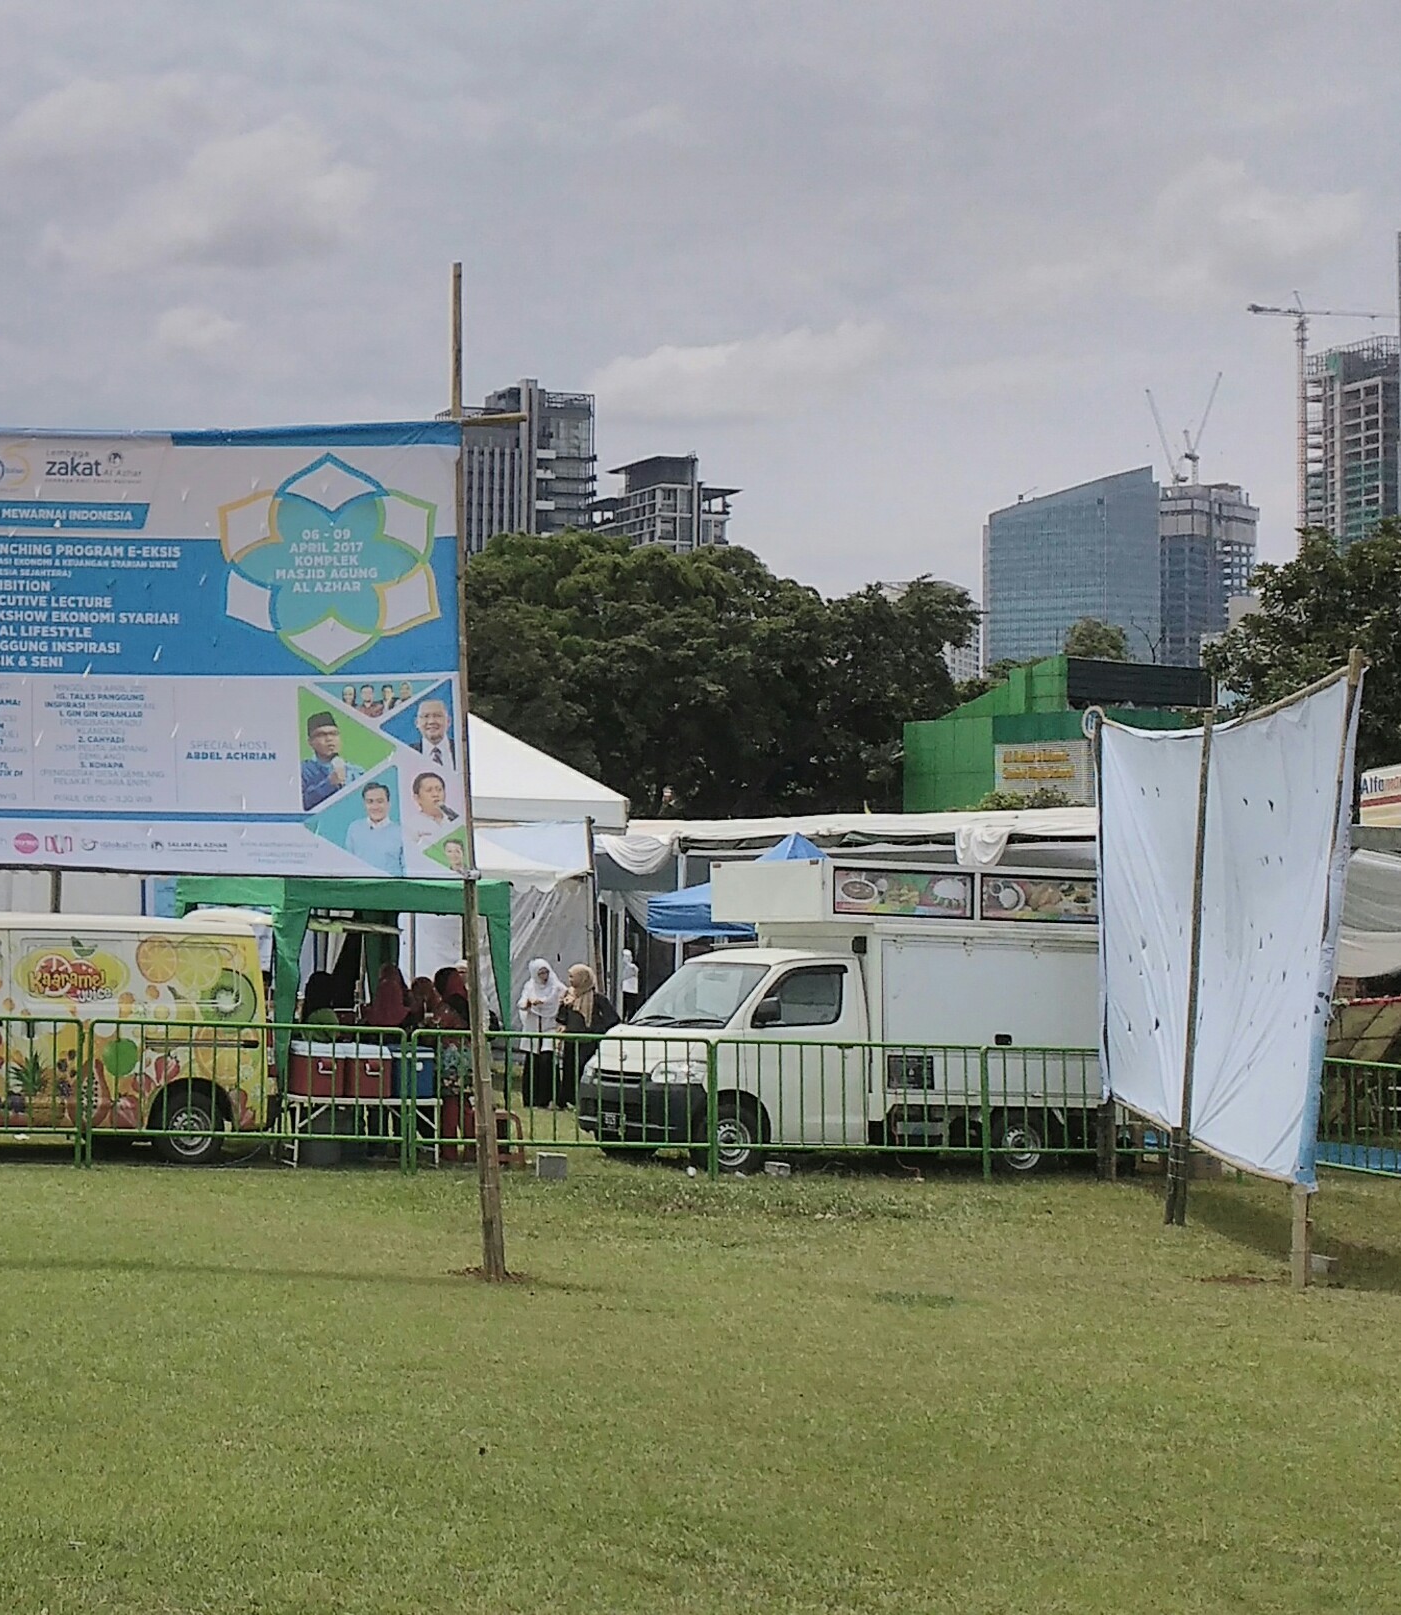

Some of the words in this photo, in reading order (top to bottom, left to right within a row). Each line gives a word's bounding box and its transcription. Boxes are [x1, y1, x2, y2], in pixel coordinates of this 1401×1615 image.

[46, 457, 102, 476] zakat
[1, 507, 66, 520] MEWARNAI
[69, 510, 133, 521] INDONESIA
[302, 529, 320, 540] 06
[333, 529, 351, 540] 09
[56, 544, 123, 557] PROGRAM
[127, 546, 181, 558] E-EKSIS
[289, 543, 329, 553] APRIL
[333, 542, 363, 553] 2017
[14, 559, 52, 567] EKONOMI
[295, 555, 359, 566] KOMPLEK
[20, 569, 72, 578] SEJAHTERA)
[275, 569, 325, 579] MASJID
[330, 568, 378, 578] AGUNG
[293, 582, 310, 593] AL
[314, 582, 361, 592] AZHAR
[51, 596, 113, 608] LECTURE
[52, 611, 115, 623] EKONOMI
[119, 612, 179, 625] SYARIAH
[21, 625, 92, 638] LIFESTYLE
[52, 642, 121, 654] INSPIRASI
[18, 655, 27, 667] &
[31, 655, 63, 668] SENI
[97, 693, 145, 701] PANGGUNG
[190, 740, 235, 750] SPECIAL
[186, 752, 222, 761] ABDEL
[226, 752, 276, 760] ACHRIAN
